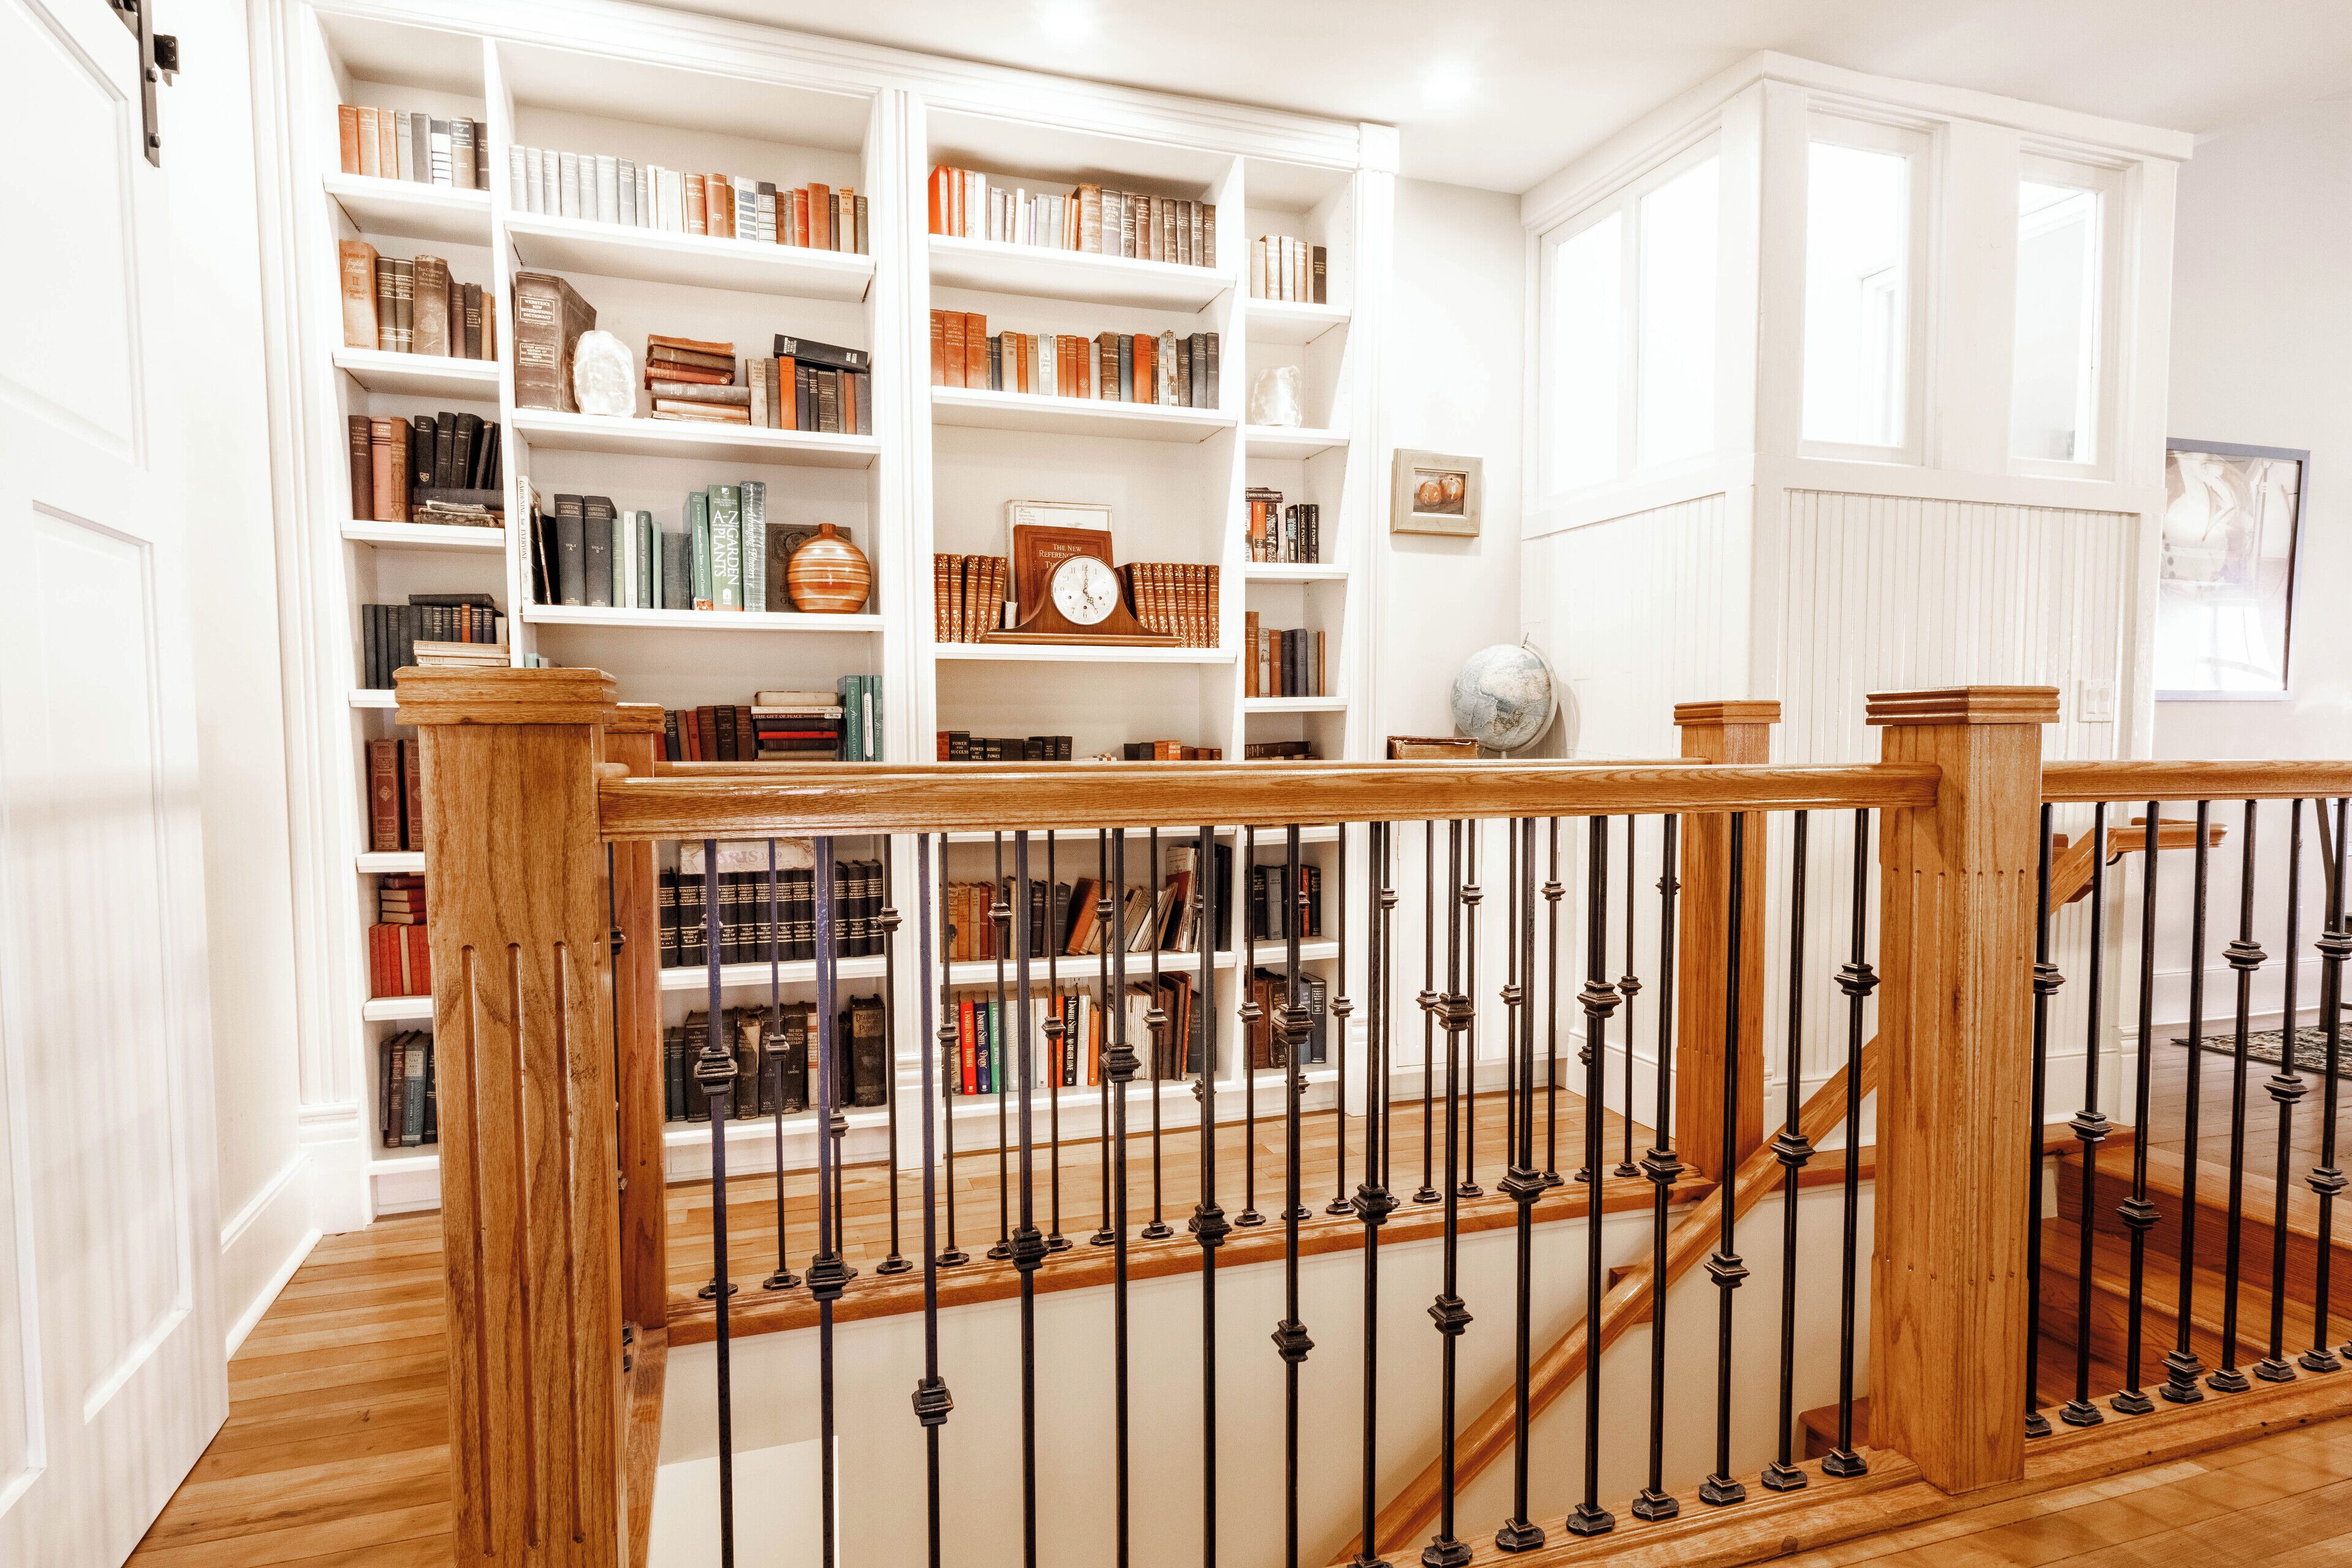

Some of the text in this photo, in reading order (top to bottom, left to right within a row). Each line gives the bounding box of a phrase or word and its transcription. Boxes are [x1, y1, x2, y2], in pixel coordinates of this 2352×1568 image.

[712, 509, 739, 525] A-Z
[714, 527, 726, 577] PLANTS
[745, 509, 757, 579] Arranging Flowers
[726, 527, 739, 585] GARDEN
[1039, 550, 1076, 559] REFERENC
[718, 850, 758, 864] ARIS
[964, 1010, 973, 1030] DANIELLE
[1068, 1000, 1077, 1023] DANIELLE
[965, 1029, 974, 1045] STEEL
[1067, 1020, 1076, 1035] STEEL
[976, 1011, 988, 1069] DANIELLE STEEL DADDY
